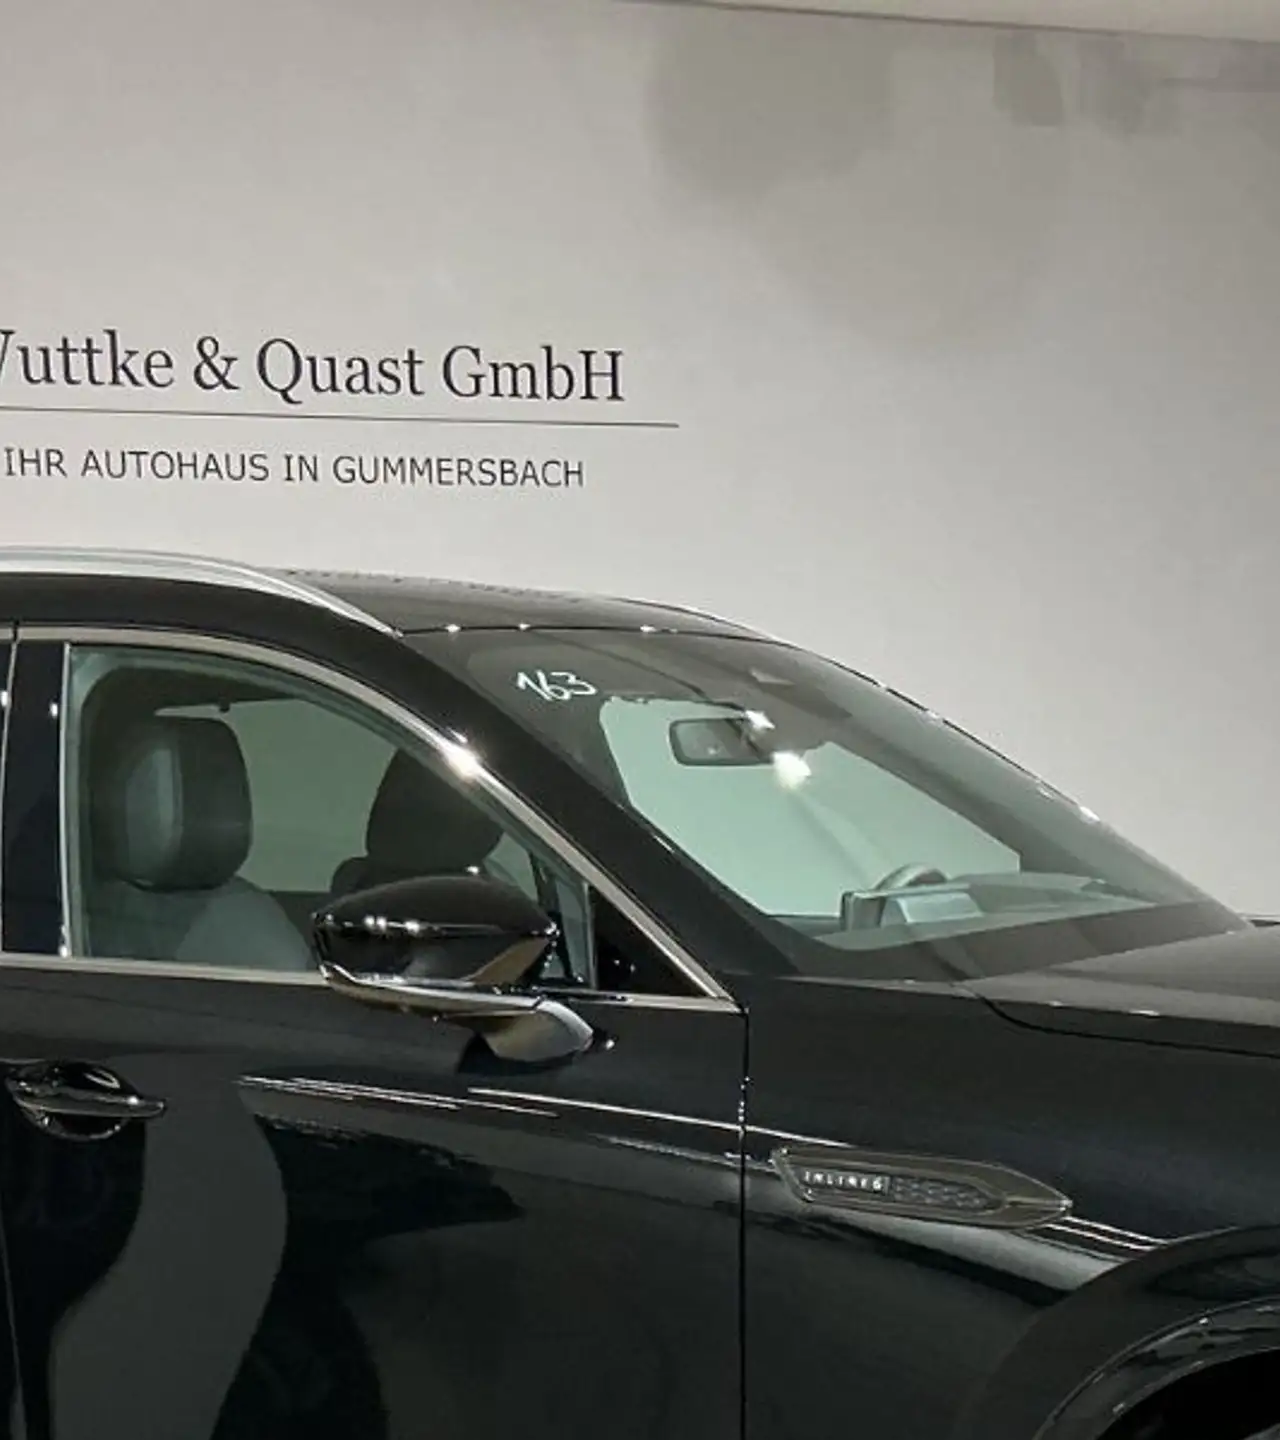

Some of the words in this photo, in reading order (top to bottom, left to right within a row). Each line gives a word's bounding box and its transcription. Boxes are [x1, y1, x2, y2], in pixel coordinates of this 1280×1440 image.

[193, 335, 241, 391] &
[256, 337, 426, 406] Quast
[442, 344, 625, 402] GmbH
[3, 446, 68, 478] IHR
[80, 449, 270, 482] AUTOHAUS
[283, 453, 319, 483] IN
[332, 455, 584, 488] GUMMERSBACH
[516, 669, 598, 702] 163
